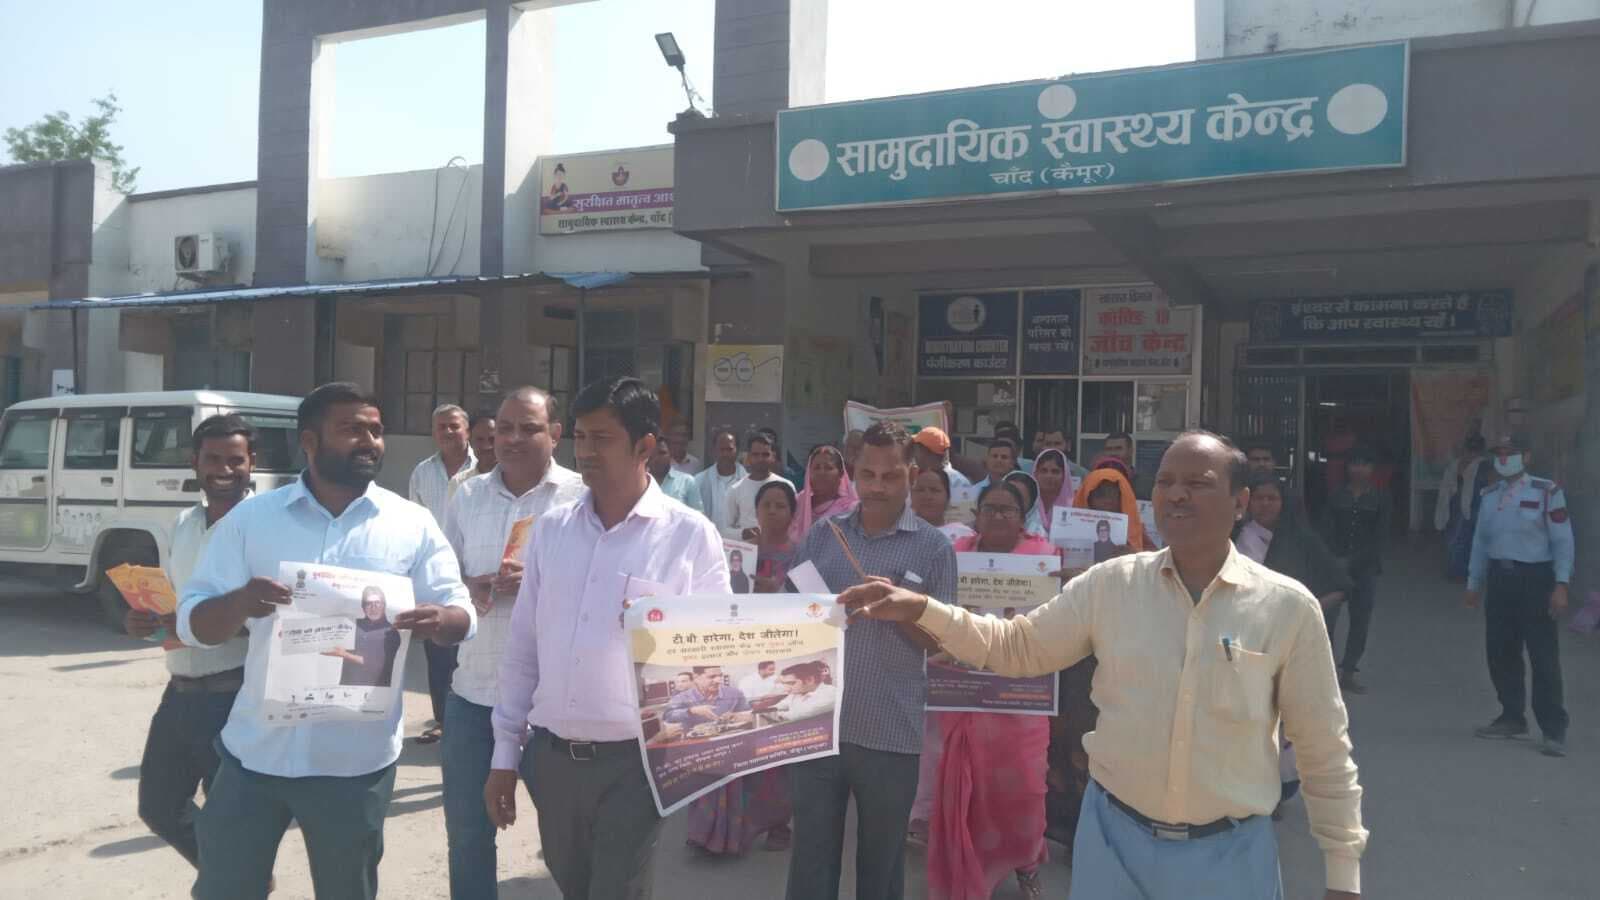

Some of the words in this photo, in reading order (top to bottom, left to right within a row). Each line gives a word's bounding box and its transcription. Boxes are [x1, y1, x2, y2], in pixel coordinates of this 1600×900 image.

[836, 119, 1031, 181] सामुदायिक
[1041, 108, 1197, 160] स्वास्थ्य
[1206, 93, 1319, 142] केन्द्र
[989, 165, 1033, 186] चाँद
[1041, 161, 1116, 186] (कैमूर)
[573, 195, 614, 213] सुरक्षित
[616, 194, 651, 210] मातृत्व
[1327, 318, 1361, 330] आप
[927, 355, 971, 369] पंजीकरण
[702, 632, 734, 645] हारेगा,
[739, 630, 755, 641] देश
